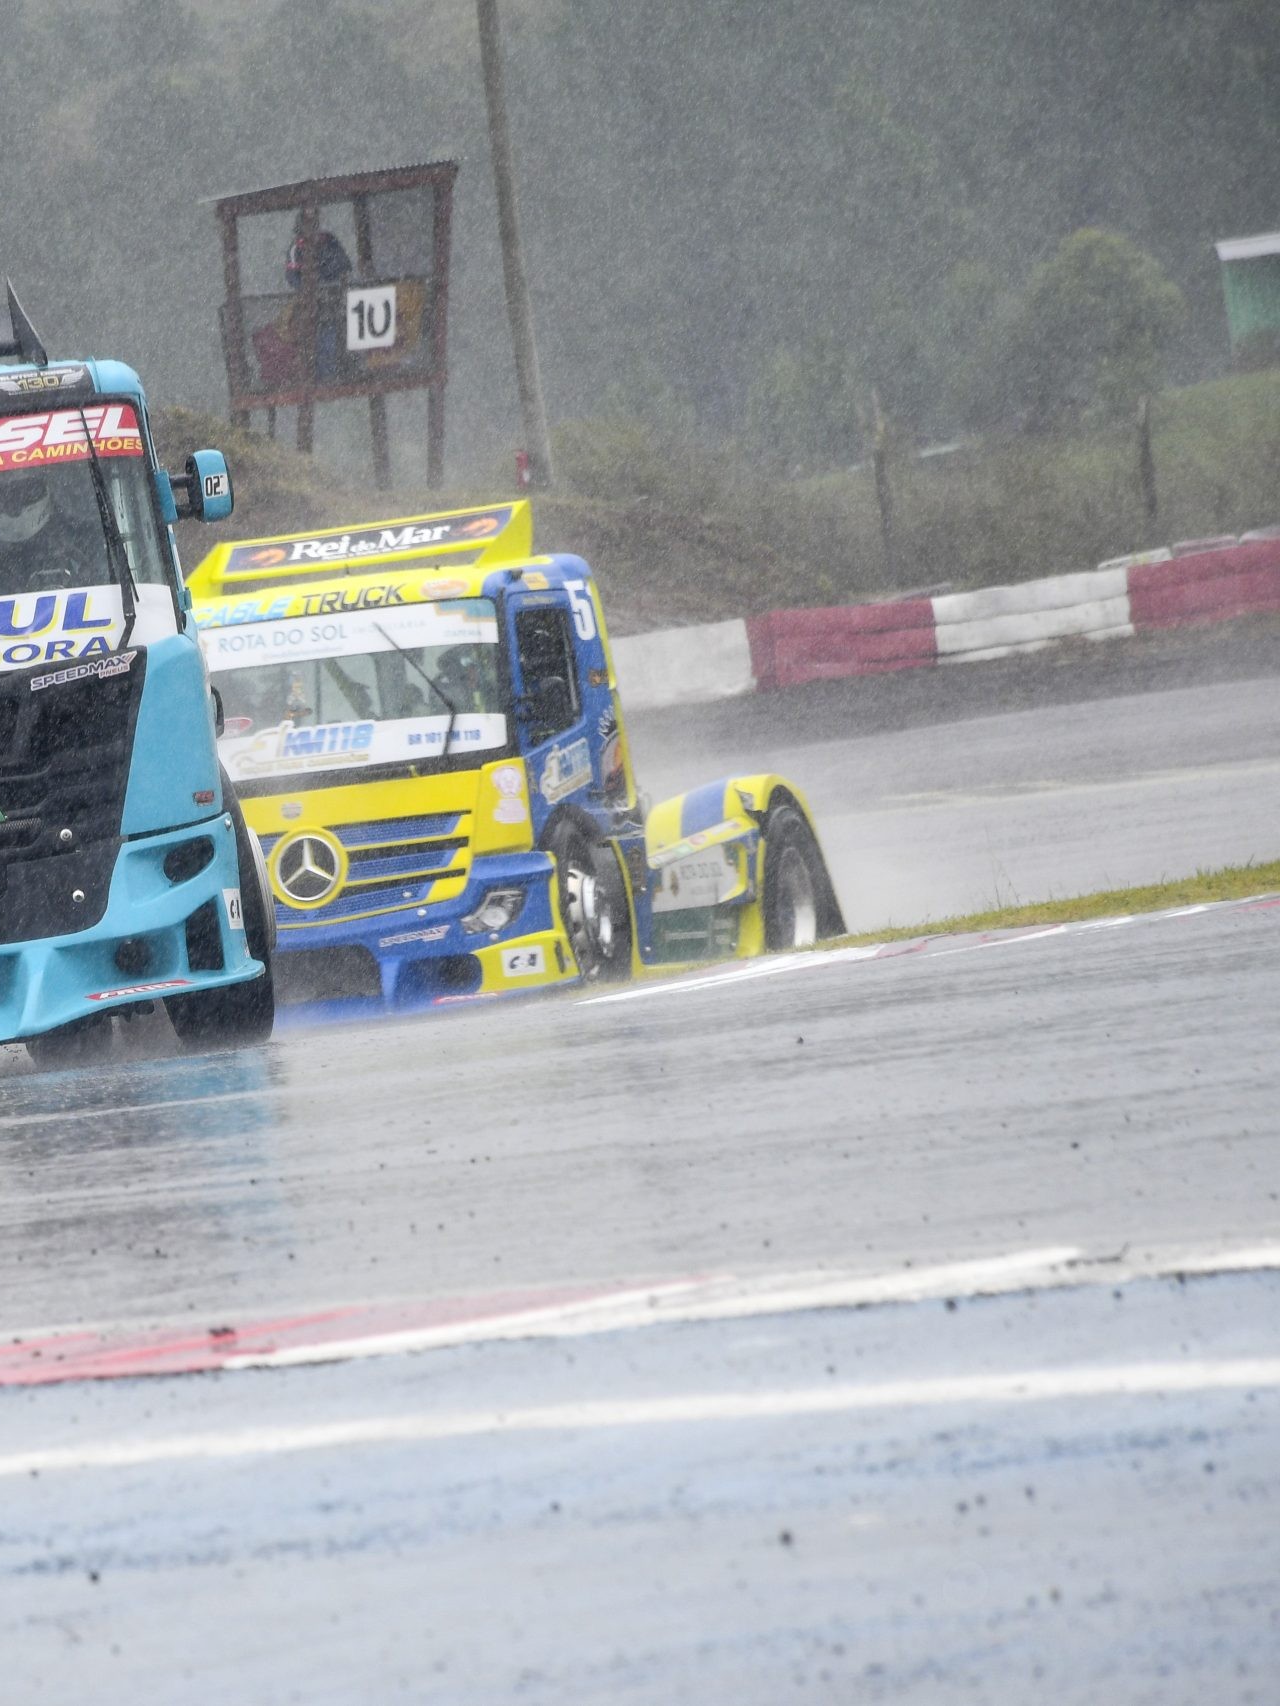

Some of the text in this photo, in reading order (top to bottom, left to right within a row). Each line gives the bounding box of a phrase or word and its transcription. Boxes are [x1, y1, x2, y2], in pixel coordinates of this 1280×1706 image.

[351, 299, 392, 340] 10
[17, 375, 59, 391] 130
[205, 475, 224, 497] 02
[288, 535, 350, 561] Rei
[376, 524, 451, 551] Mar
[301, 583, 407, 617] TRUCK
[218, 633, 267, 654] ROTA
[272, 629, 303, 646] DO
[310, 624, 348, 642] SOL
[31, 654, 127, 690] SPEEDMAX
[99, 664, 129, 678] PNEUS
[283, 724, 374, 757] KM118
